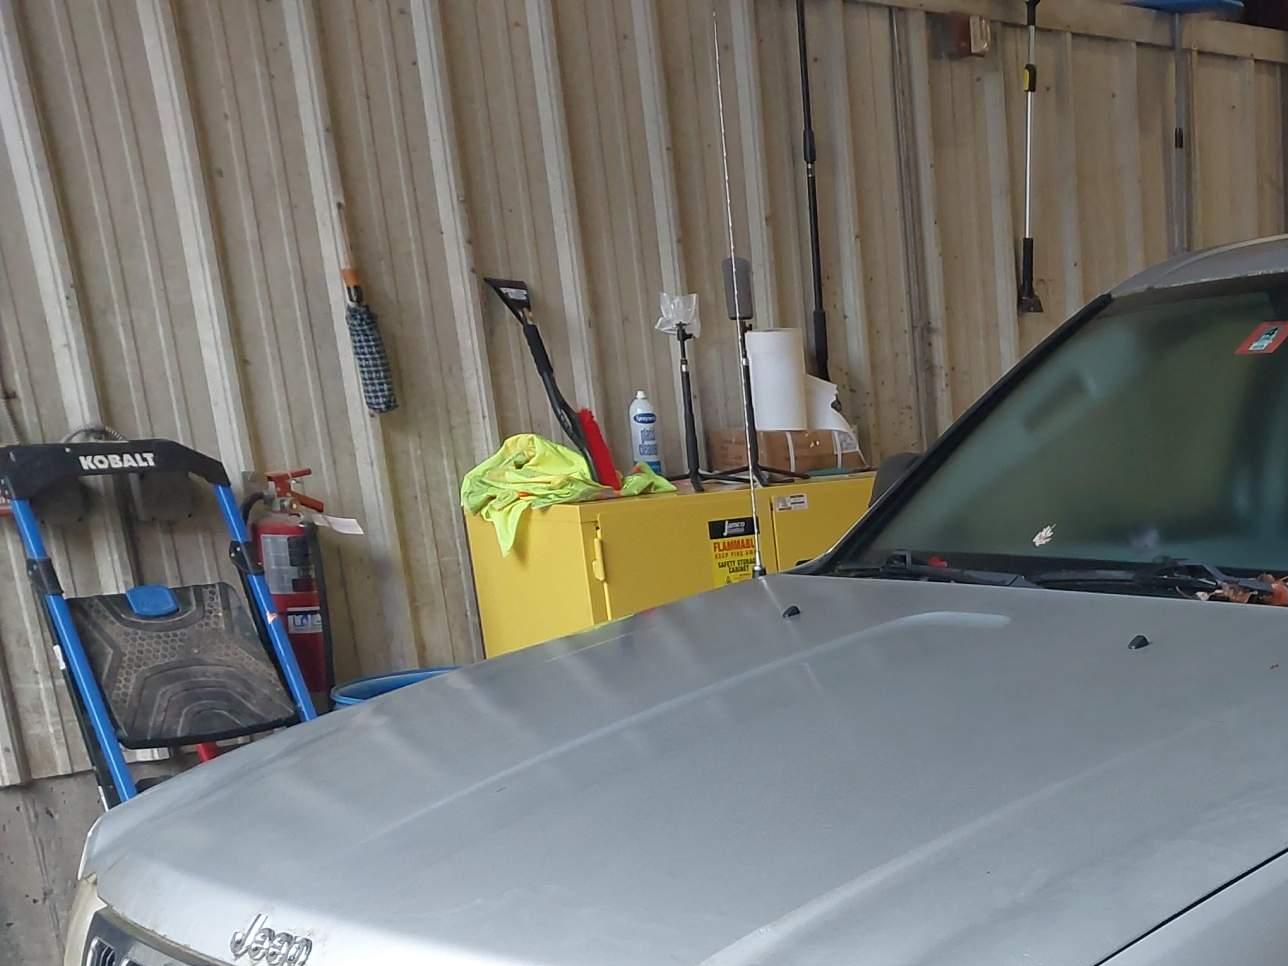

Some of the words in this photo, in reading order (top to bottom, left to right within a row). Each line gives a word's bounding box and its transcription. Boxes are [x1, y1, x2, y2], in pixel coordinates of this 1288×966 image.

[79, 453, 155, 470] KOBALT
[713, 538, 755, 552] FLAMMABL
[718, 560, 736, 568] SAFETY
